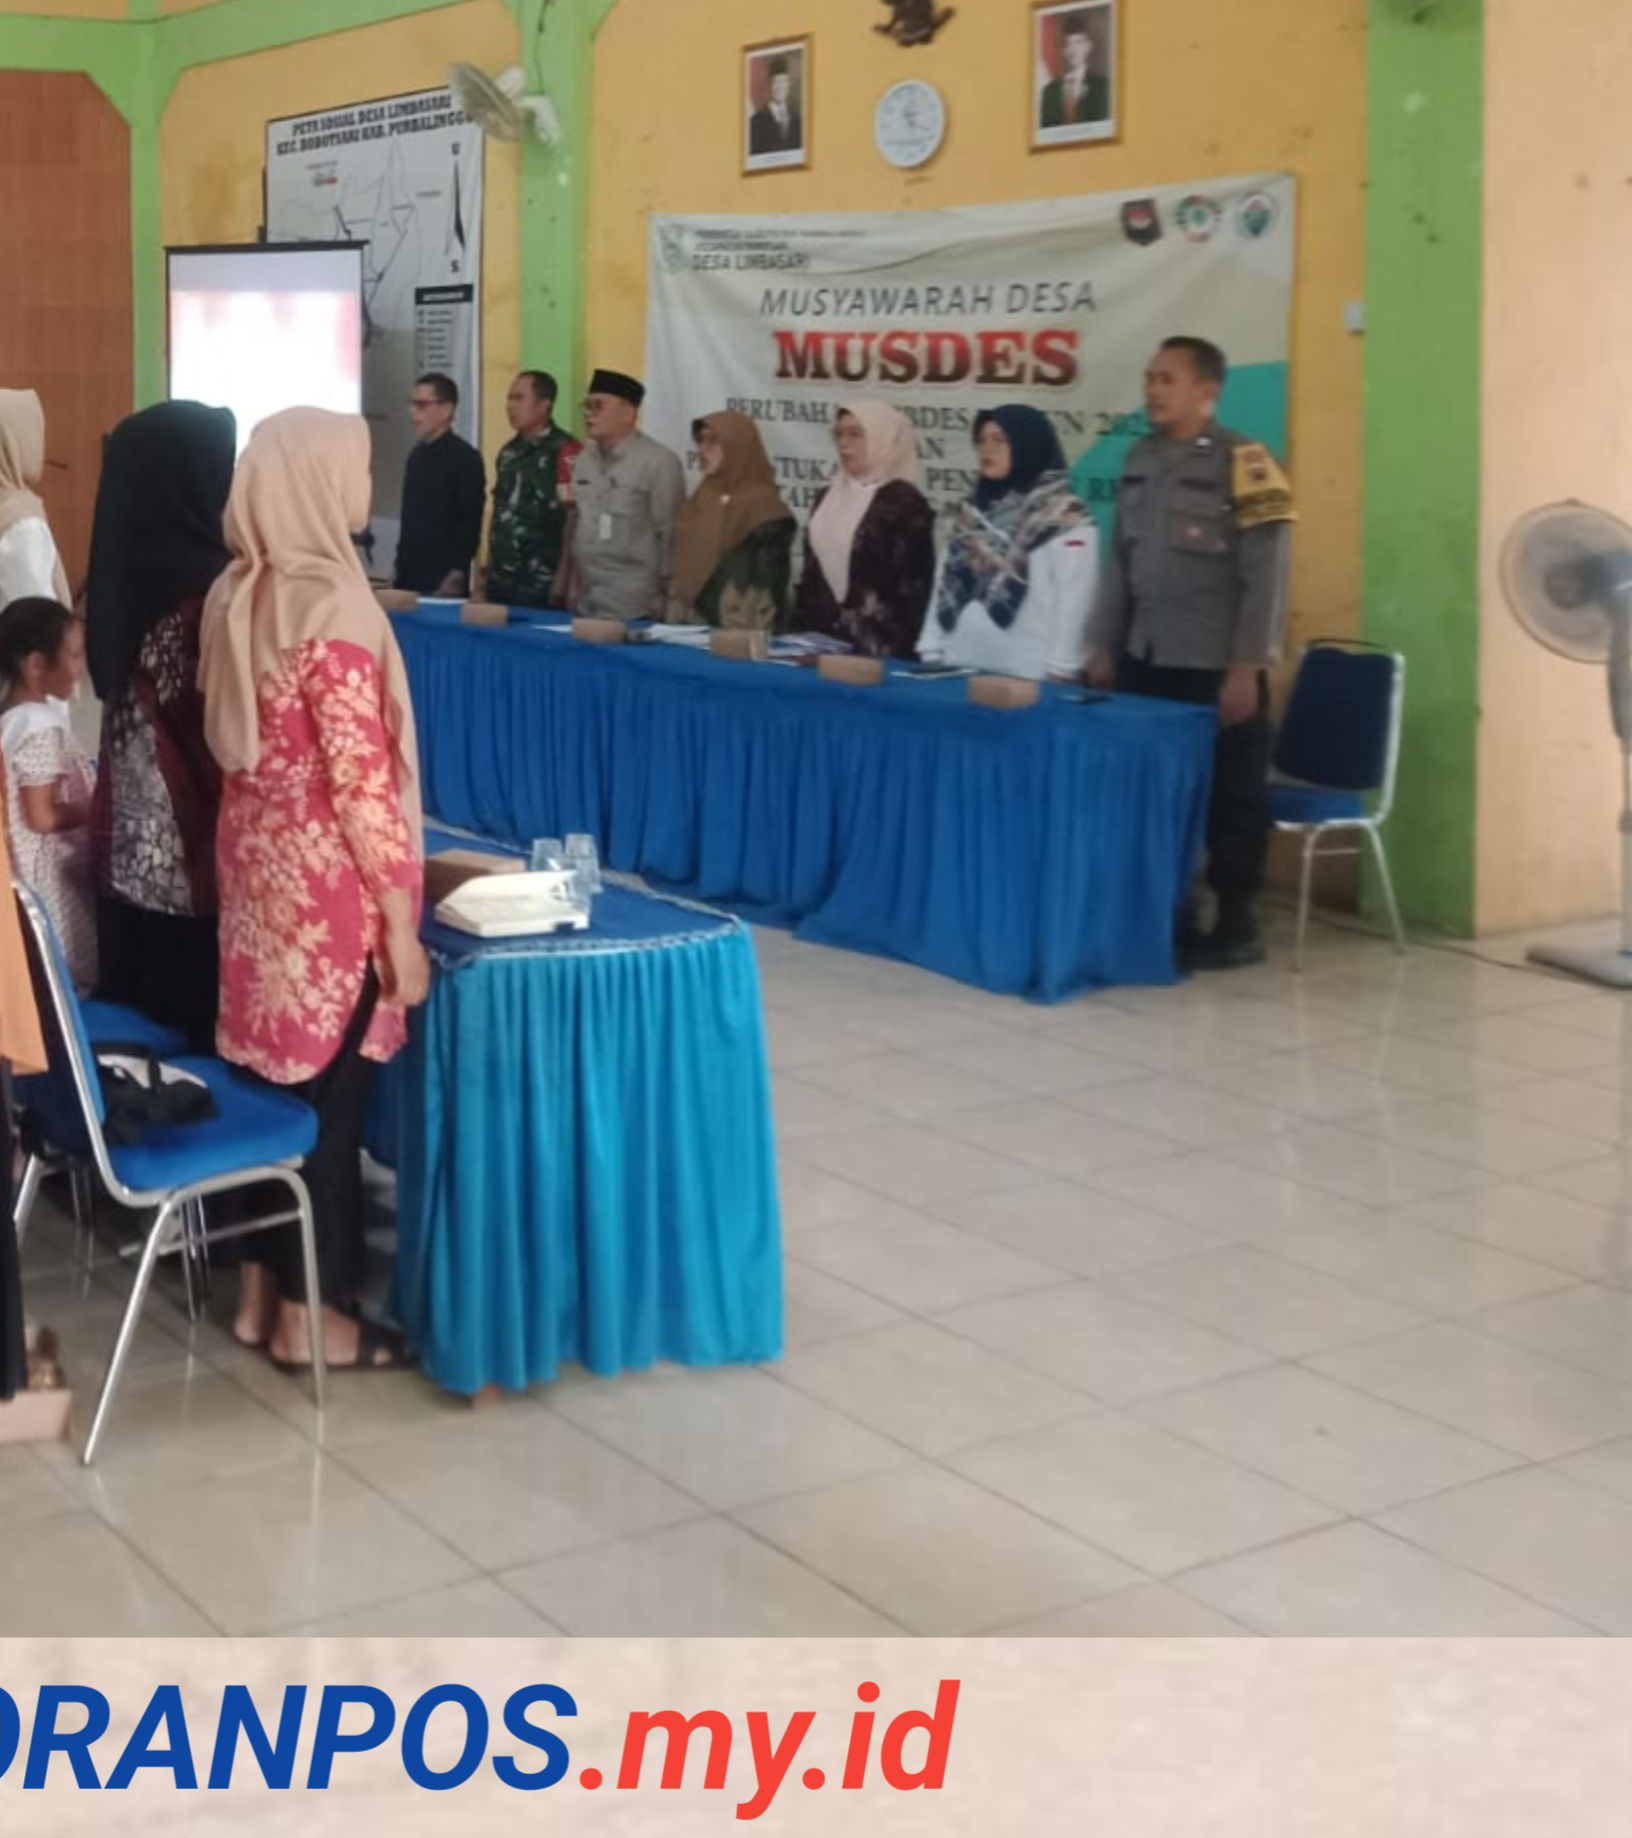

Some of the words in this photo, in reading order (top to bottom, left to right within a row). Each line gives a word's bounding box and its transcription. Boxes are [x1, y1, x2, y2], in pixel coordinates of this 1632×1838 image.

[358, 106, 386, 124] DESA
[693, 252, 730, 271] DESA
[759, 283, 995, 317] MUSYAWARAH
[1006, 280, 1099, 314] DESA
[772, 329, 1081, 387] MUSDES
